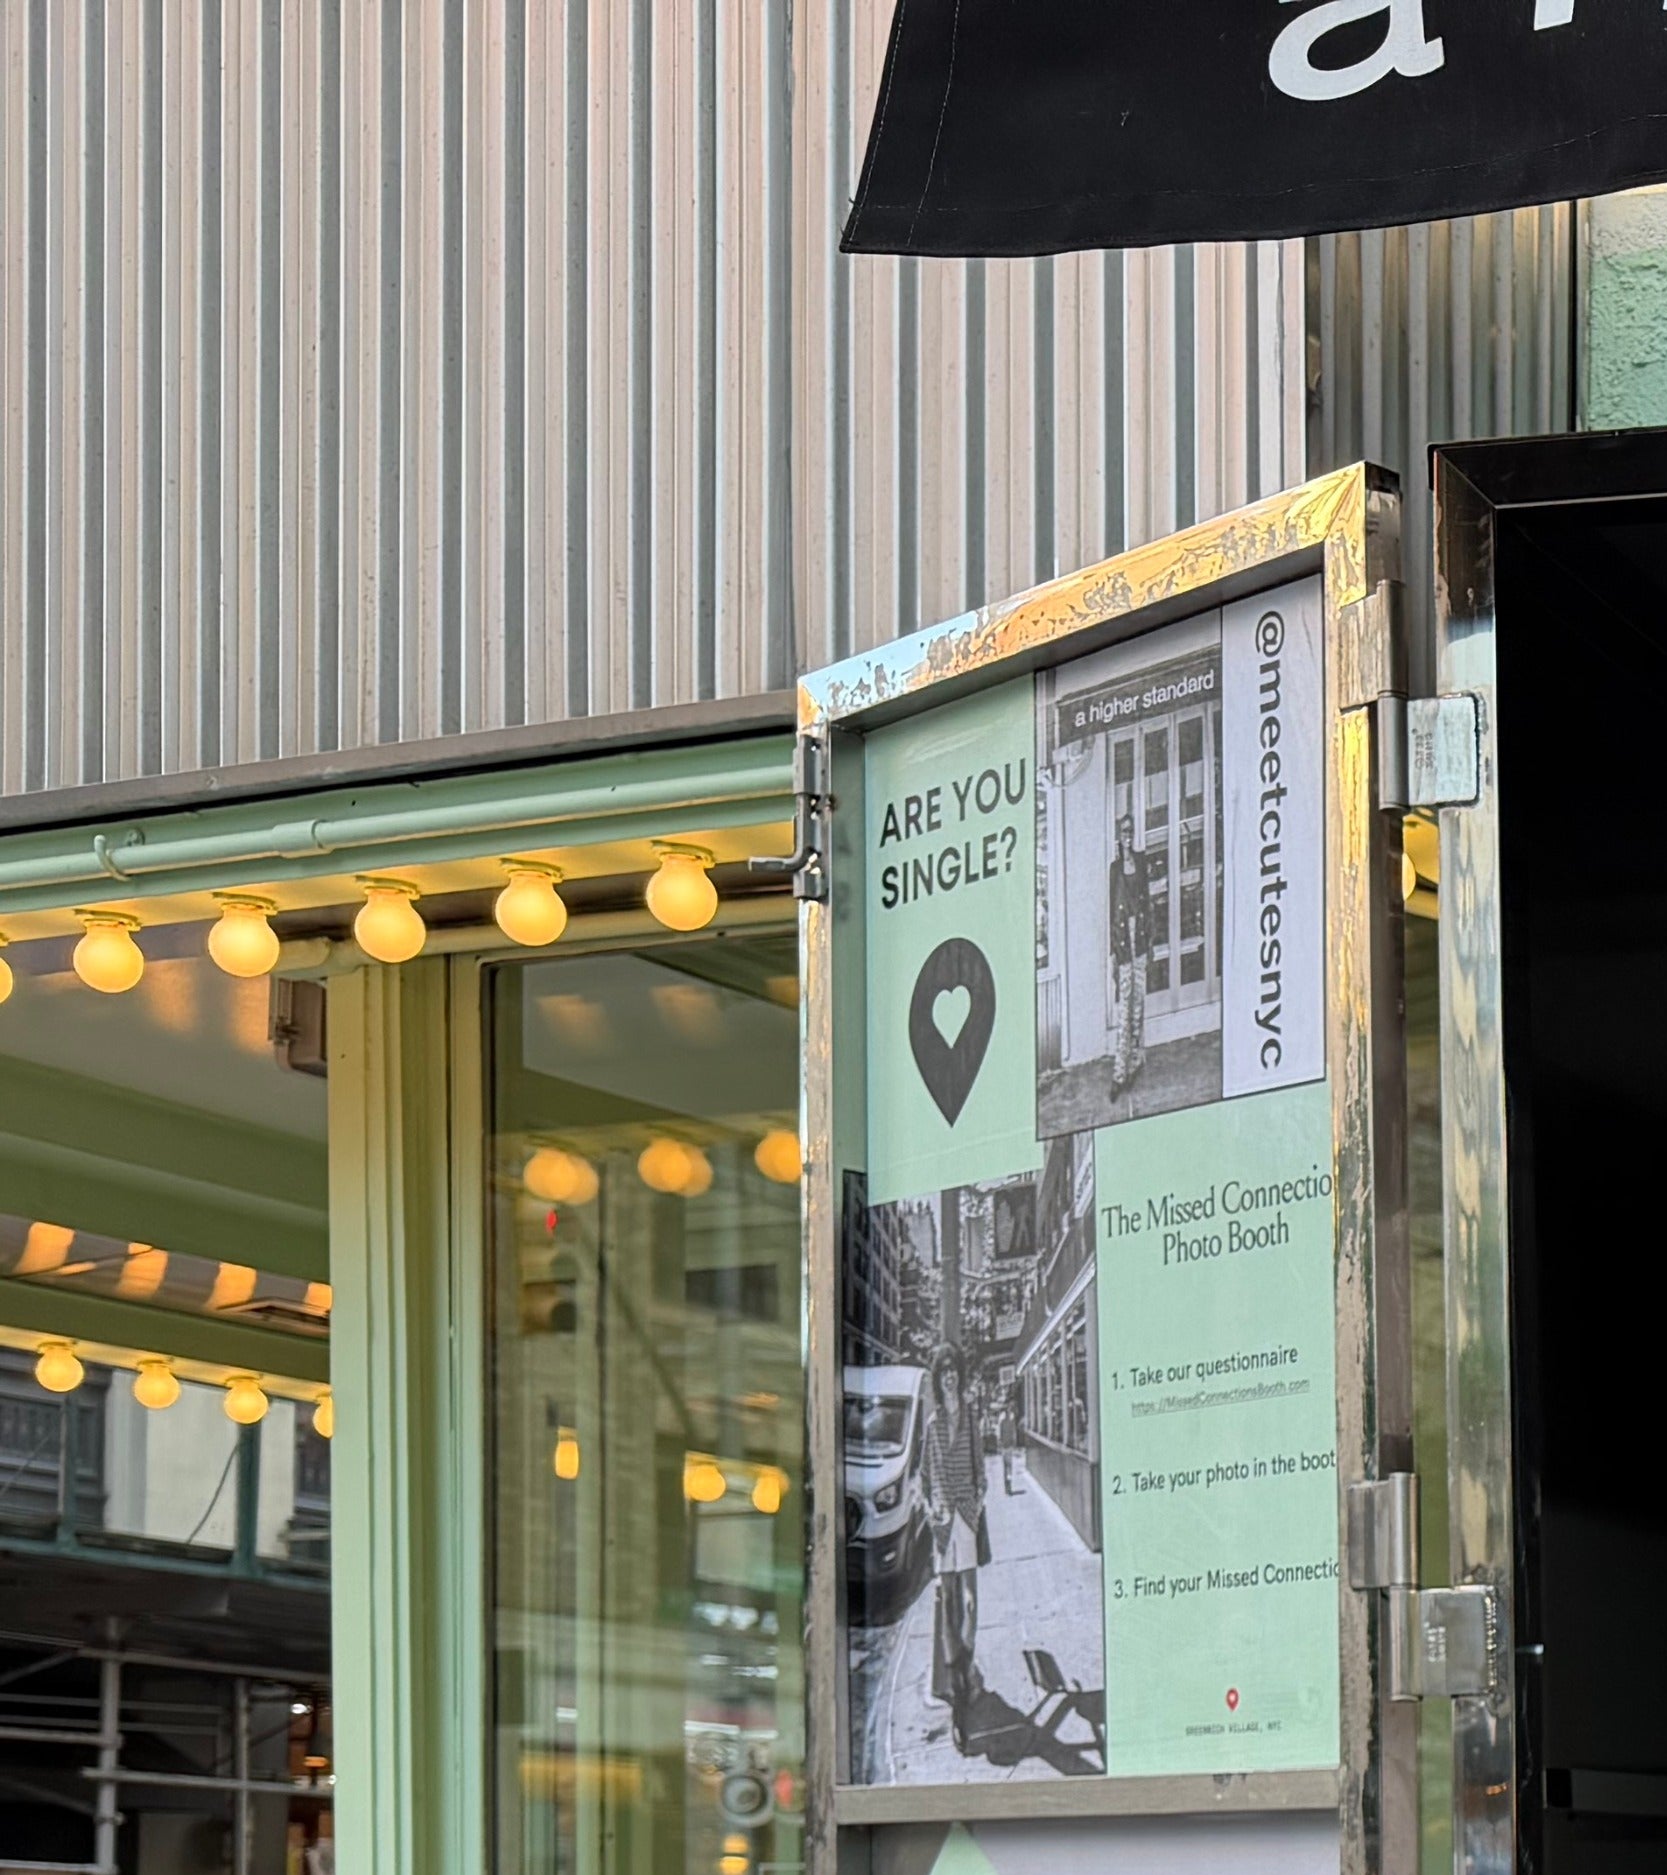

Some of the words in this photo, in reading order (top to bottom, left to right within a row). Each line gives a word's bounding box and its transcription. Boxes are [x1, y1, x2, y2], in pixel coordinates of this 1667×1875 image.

[1074, 712, 1087, 728] a
[1088, 694, 1140, 724] higher
[1141, 670, 1215, 707] standard
[878, 786, 942, 848] ARE
[952, 757, 1026, 821] YOU
[881, 826, 1018, 910] SINGLE?
[1254, 609, 1290, 1071] @meetcutesnyc
[1101, 1204, 1142, 1238] The
[1147, 1185, 1216, 1231] Missed
[1221, 1163, 1333, 1215] Connectio
[1163, 1230, 1223, 1266] Photo
[1228, 1211, 1290, 1254] Booth
[1112, 1371, 1125, 1390] 1.
[1130, 1365, 1164, 1388] Take
[1167, 1365, 1191, 1382] our
[1196, 1345, 1299, 1383] questionnaire
[1112, 1474, 1127, 1495] 2.
[1131, 1471, 1165, 1493] Take
[1169, 1469, 1201, 1493] your
[1206, 1462, 1250, 1488] photo
[1253, 1457, 1268, 1478] in
[1271, 1454, 1296, 1475] the
[1301, 1449, 1336, 1472] boot
[1114, 1579, 1129, 1599] 3.
[1134, 1575, 1166, 1598] Find
[1170, 1574, 1202, 1599] your
[1207, 1566, 1259, 1590] Missed
